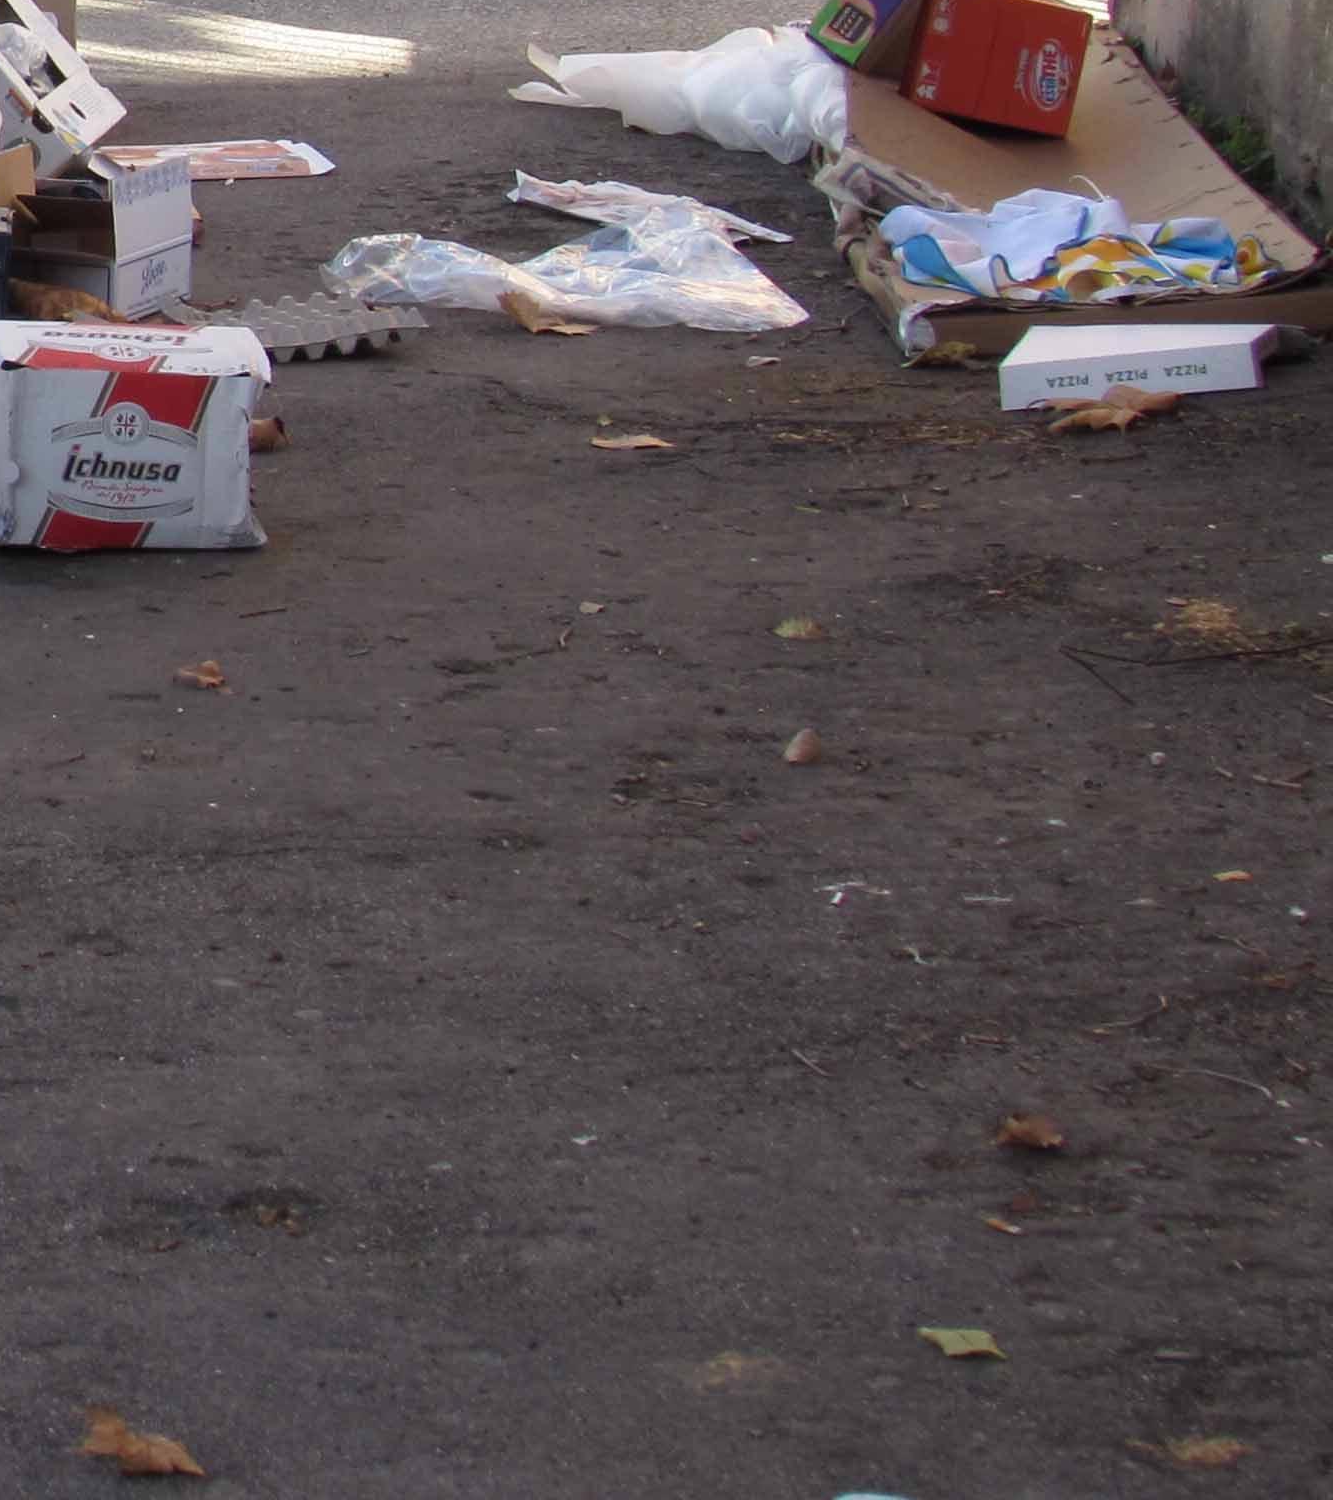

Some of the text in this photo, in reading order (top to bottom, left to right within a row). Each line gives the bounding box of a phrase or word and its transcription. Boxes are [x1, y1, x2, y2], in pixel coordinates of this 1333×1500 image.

[43, 328, 189, 346] ichnusa
[1046, 363, 1208, 389] PIZZA PIZZA PIZZA
[62, 443, 182, 484] ichnusa
